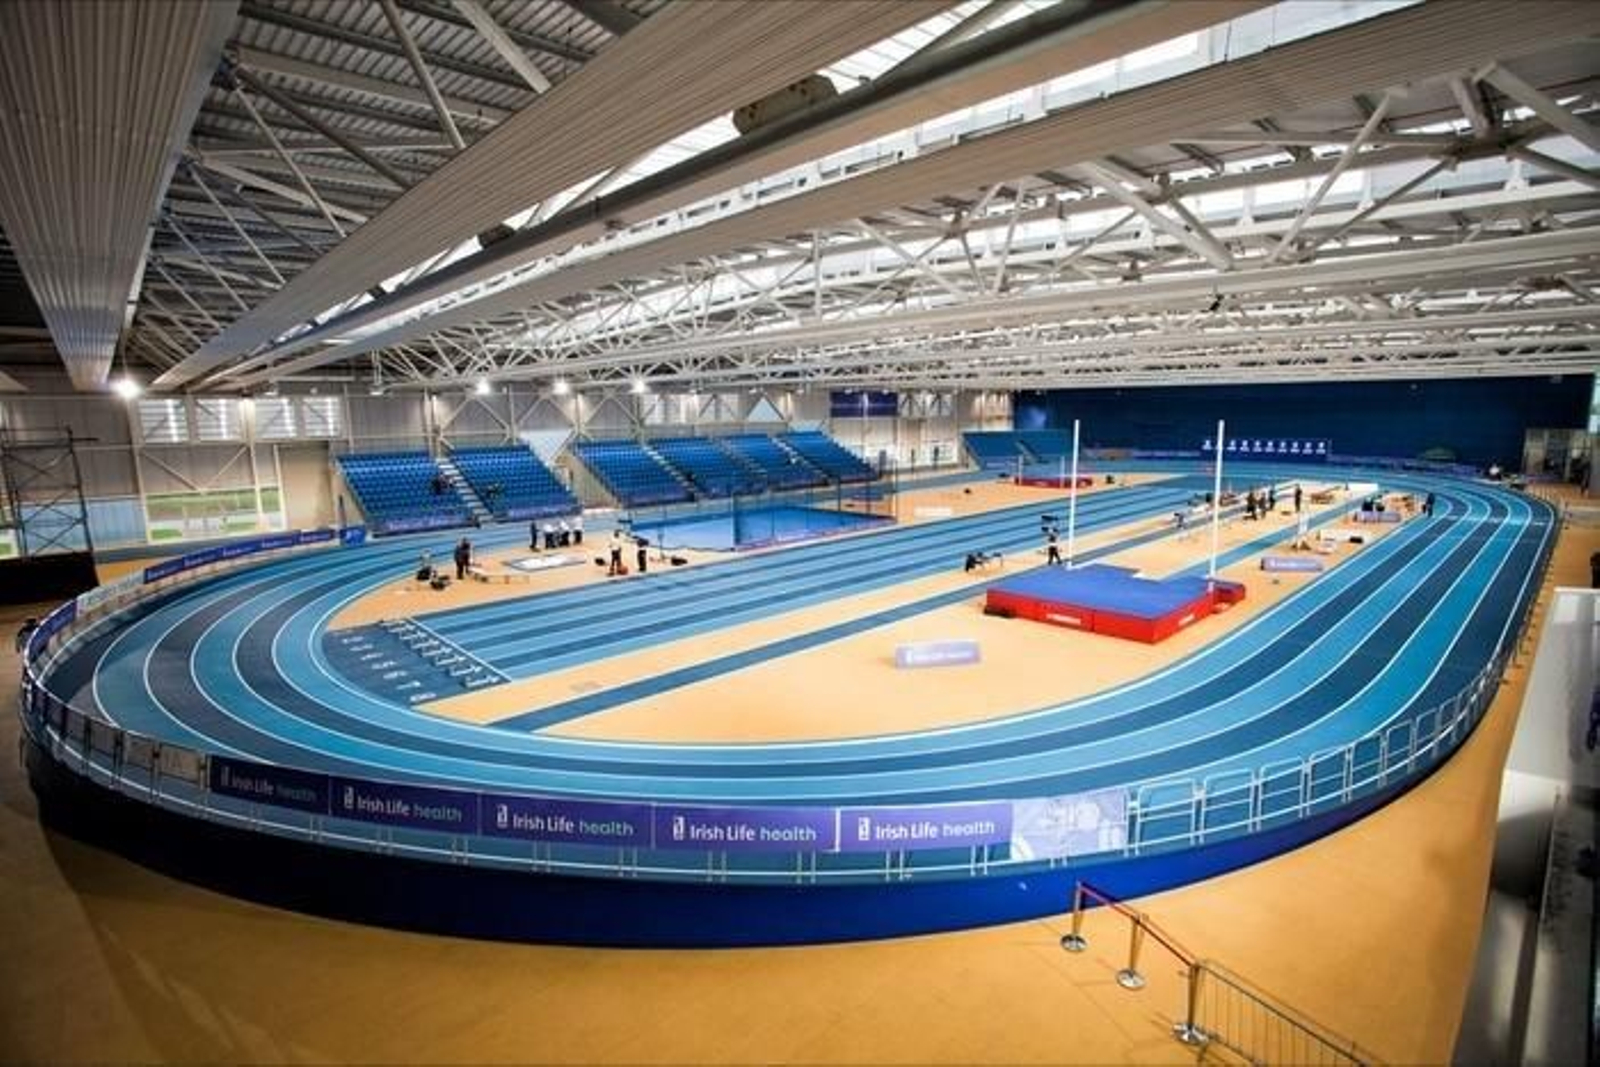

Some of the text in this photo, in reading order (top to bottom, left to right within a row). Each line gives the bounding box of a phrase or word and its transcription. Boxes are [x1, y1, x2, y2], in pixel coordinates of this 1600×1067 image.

[357, 795, 463, 822] Irish Life health
[513, 813, 634, 836] Irish Life health
[690, 823, 817, 841] Irish Life health
[875, 821, 995, 840] Irish Life health
